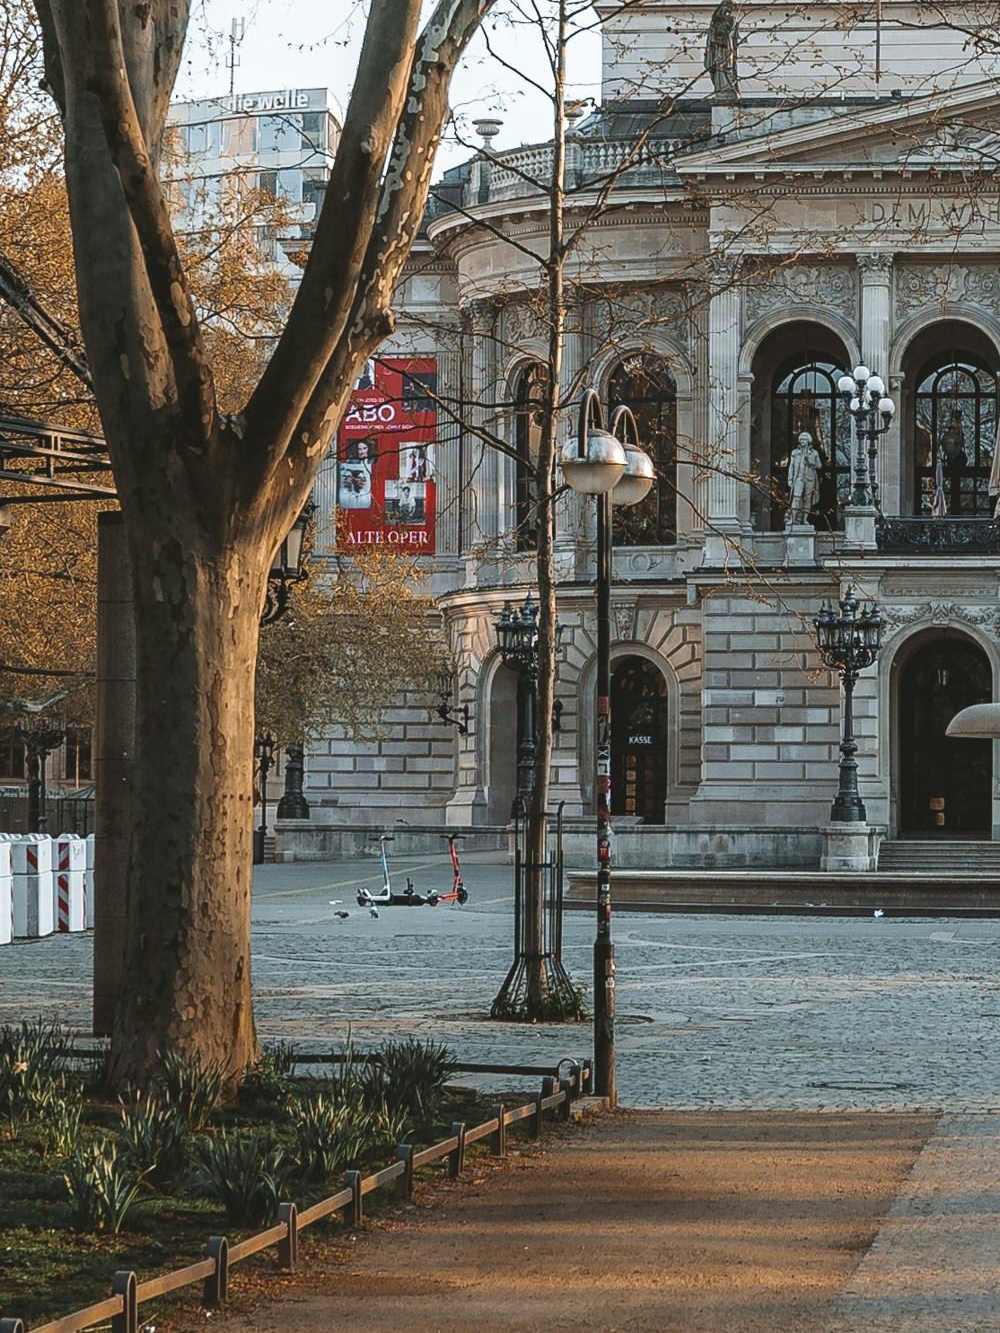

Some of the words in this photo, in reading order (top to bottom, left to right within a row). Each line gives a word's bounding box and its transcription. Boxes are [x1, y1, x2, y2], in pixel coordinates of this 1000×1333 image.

[227, 93, 254, 112] die
[257, 88, 309, 110] welle
[871, 202, 926, 222] DEM
[345, 404, 396, 422] ABO
[346, 530, 384, 543] ALTE
[387, 530, 429, 543] OPER
[628, 736, 652, 744] KASSE
